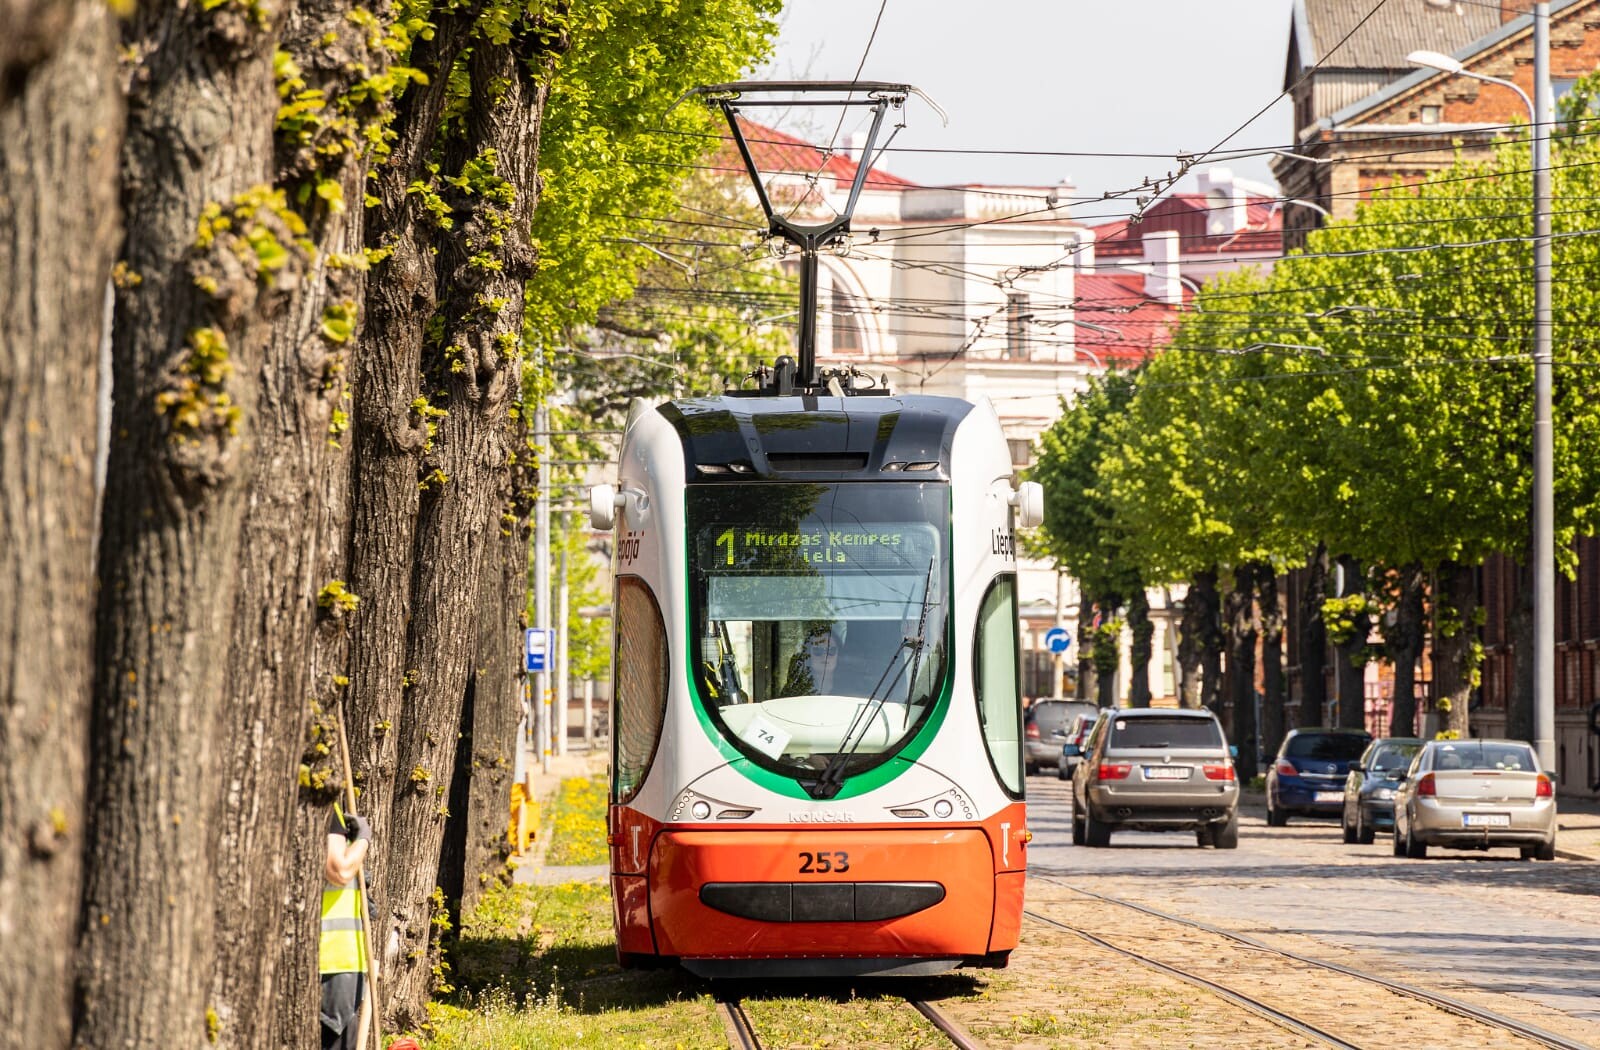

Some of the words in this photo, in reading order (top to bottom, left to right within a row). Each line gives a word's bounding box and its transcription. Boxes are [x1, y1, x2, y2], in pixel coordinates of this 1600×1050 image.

[716, 528, 734, 565] 1
[745, 531, 820, 546] Mirdzas
[803, 548, 846, 563] iela
[757, 729, 775, 745] 74
[798, 852, 850, 874] 253
